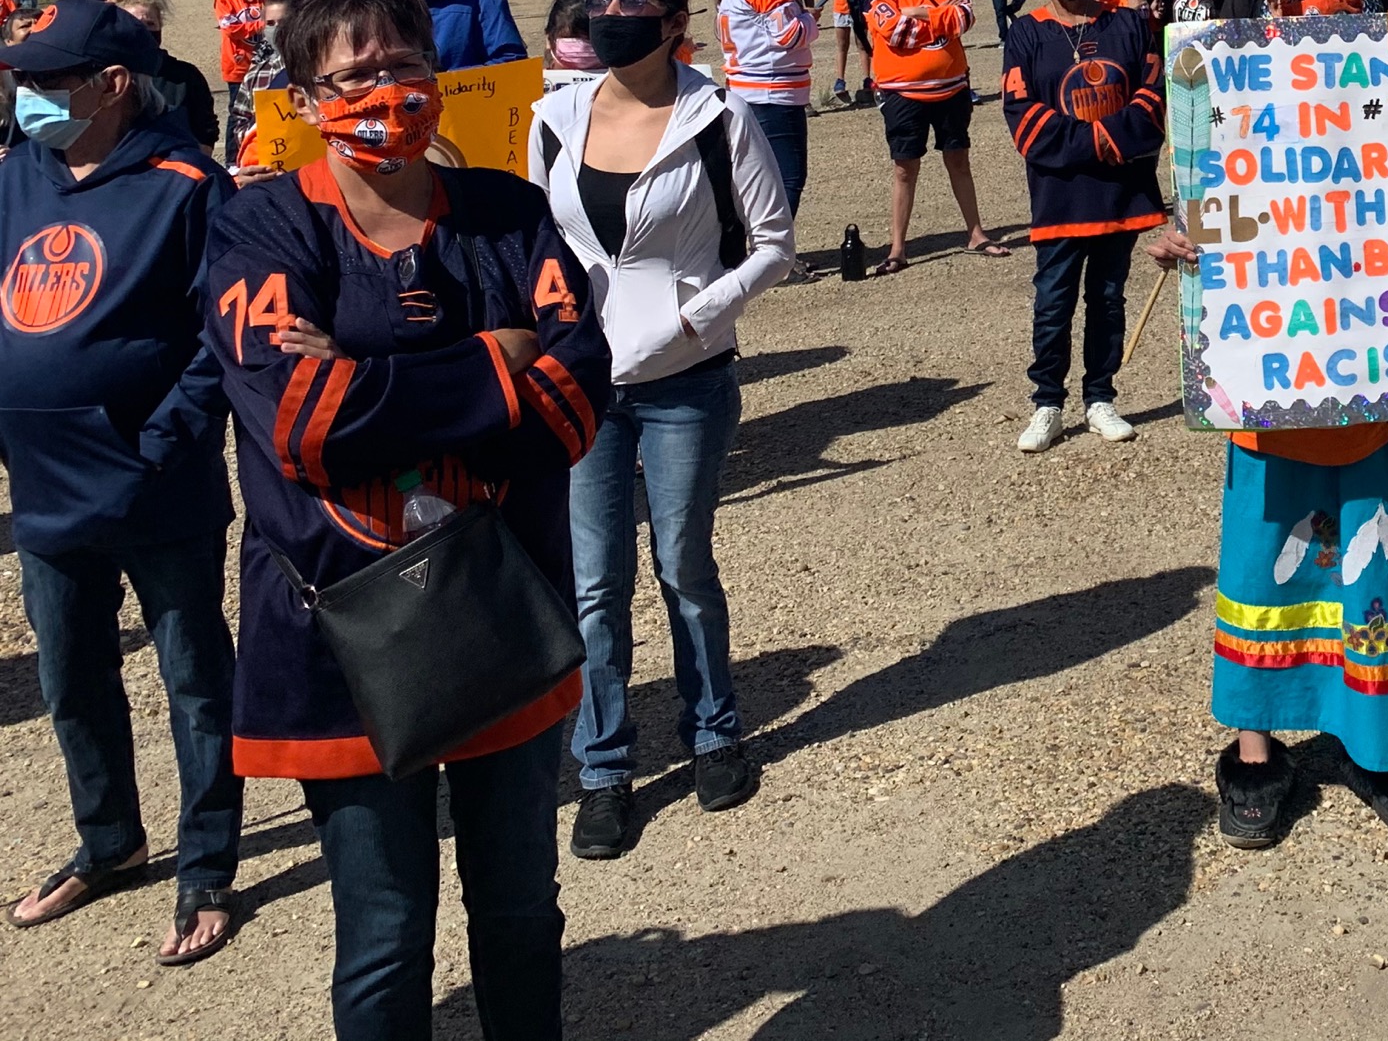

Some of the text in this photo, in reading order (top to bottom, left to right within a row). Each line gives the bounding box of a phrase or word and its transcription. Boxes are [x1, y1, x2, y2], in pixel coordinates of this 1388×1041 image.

[872, 2, 895, 28] 29
[440, 76, 496, 98] lidarity
[1211, 52, 1273, 93] WE
[1071, 84, 1124, 123] OILERS
[1299, 101, 1353, 139] IN
[1269, 188, 1386, 235] WITH
[12, 262, 90, 327] OILERS
[218, 272, 298, 365] 74
